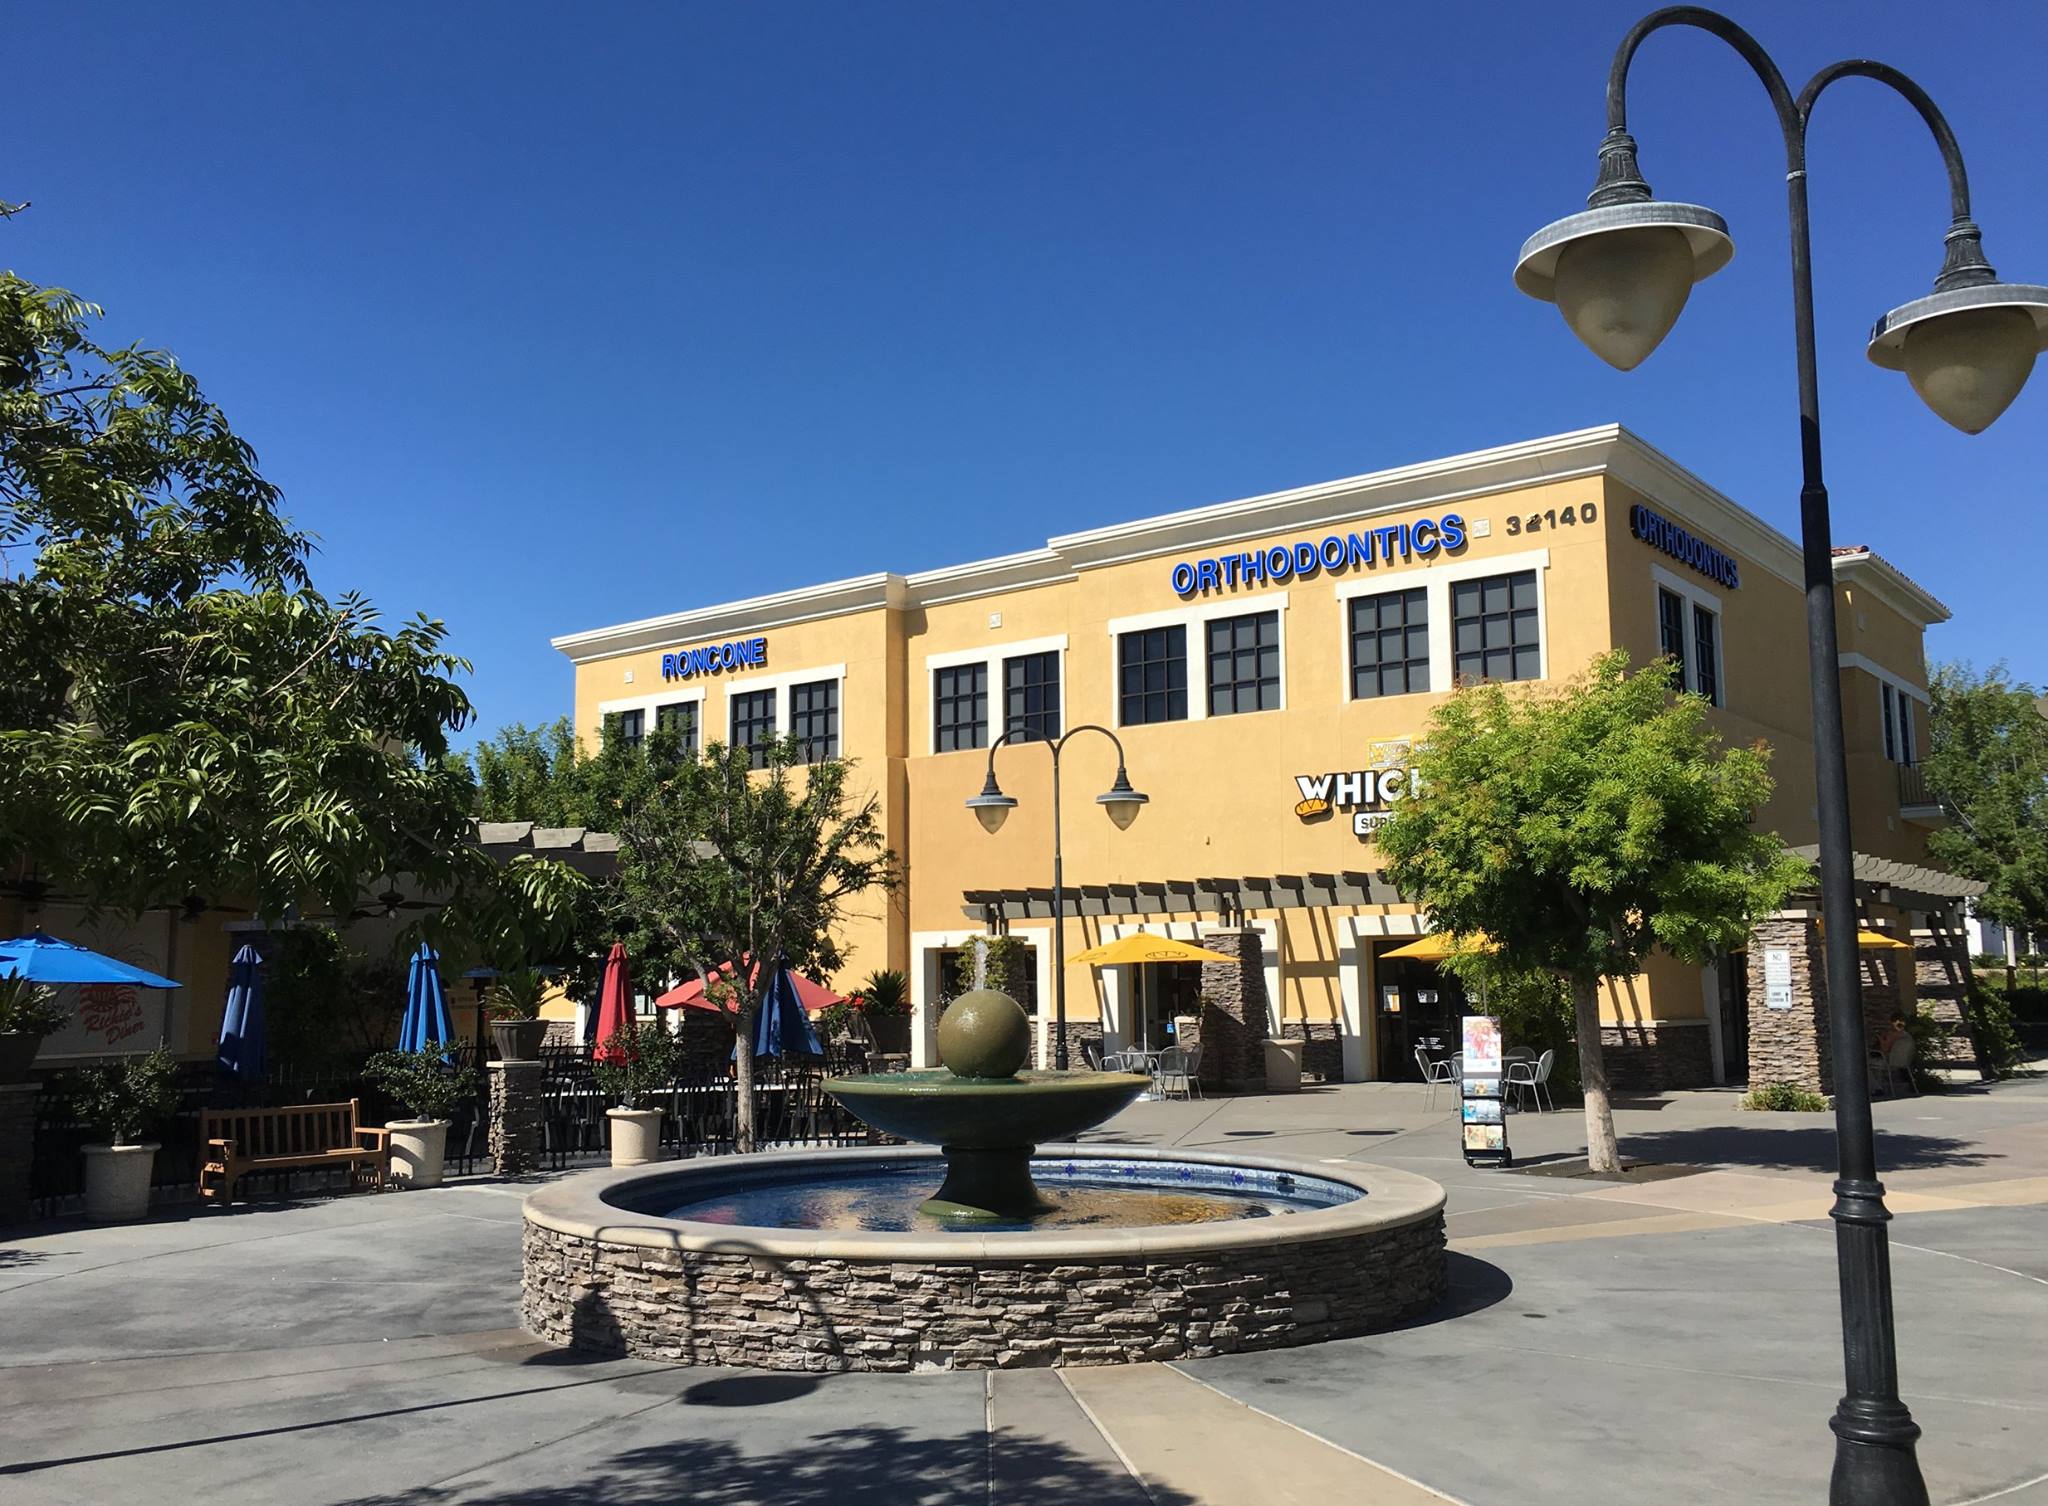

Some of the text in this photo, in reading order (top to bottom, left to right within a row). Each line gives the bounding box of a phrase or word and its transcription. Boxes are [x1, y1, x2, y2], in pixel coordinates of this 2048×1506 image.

[1506, 502, 1597, 536] 32140
[1171, 513, 1465, 594] ORTHODONTICS
[1633, 504, 1740, 588] ORTHODONTICS
[662, 637, 765, 678] RONCONE
[1360, 816, 1388, 830] SUP
[106, 1022, 145, 1044] Diner
